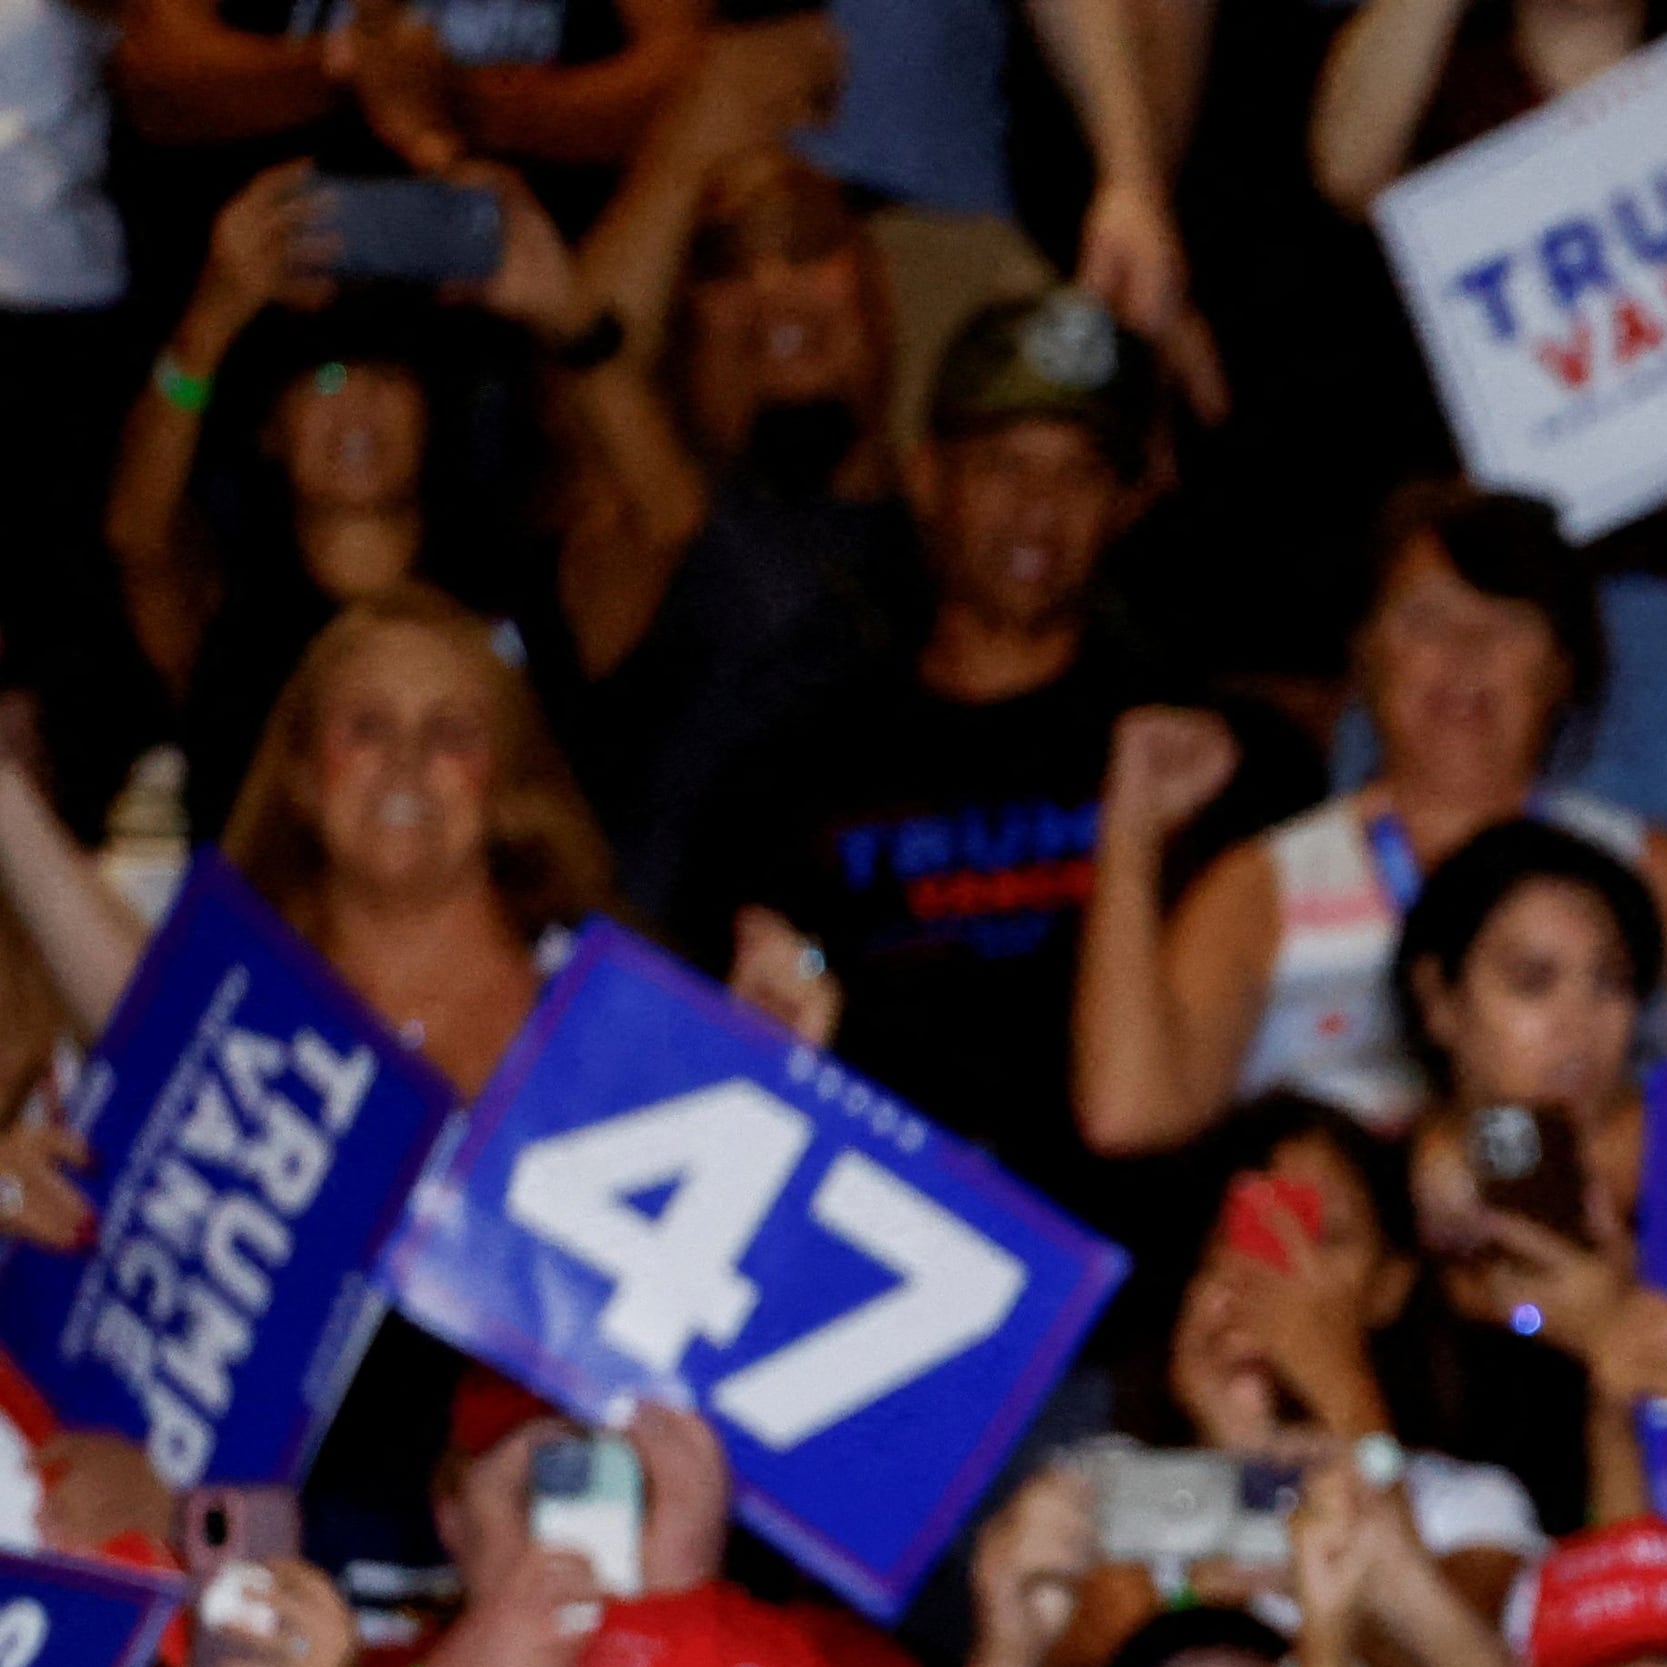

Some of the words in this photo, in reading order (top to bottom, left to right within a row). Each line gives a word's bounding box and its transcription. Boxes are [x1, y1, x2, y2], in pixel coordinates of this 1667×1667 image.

[92, 1026, 288, 1378] VANCE
[147, 1026, 380, 1490] TRUMP
[507, 1076, 1028, 1452] 47
